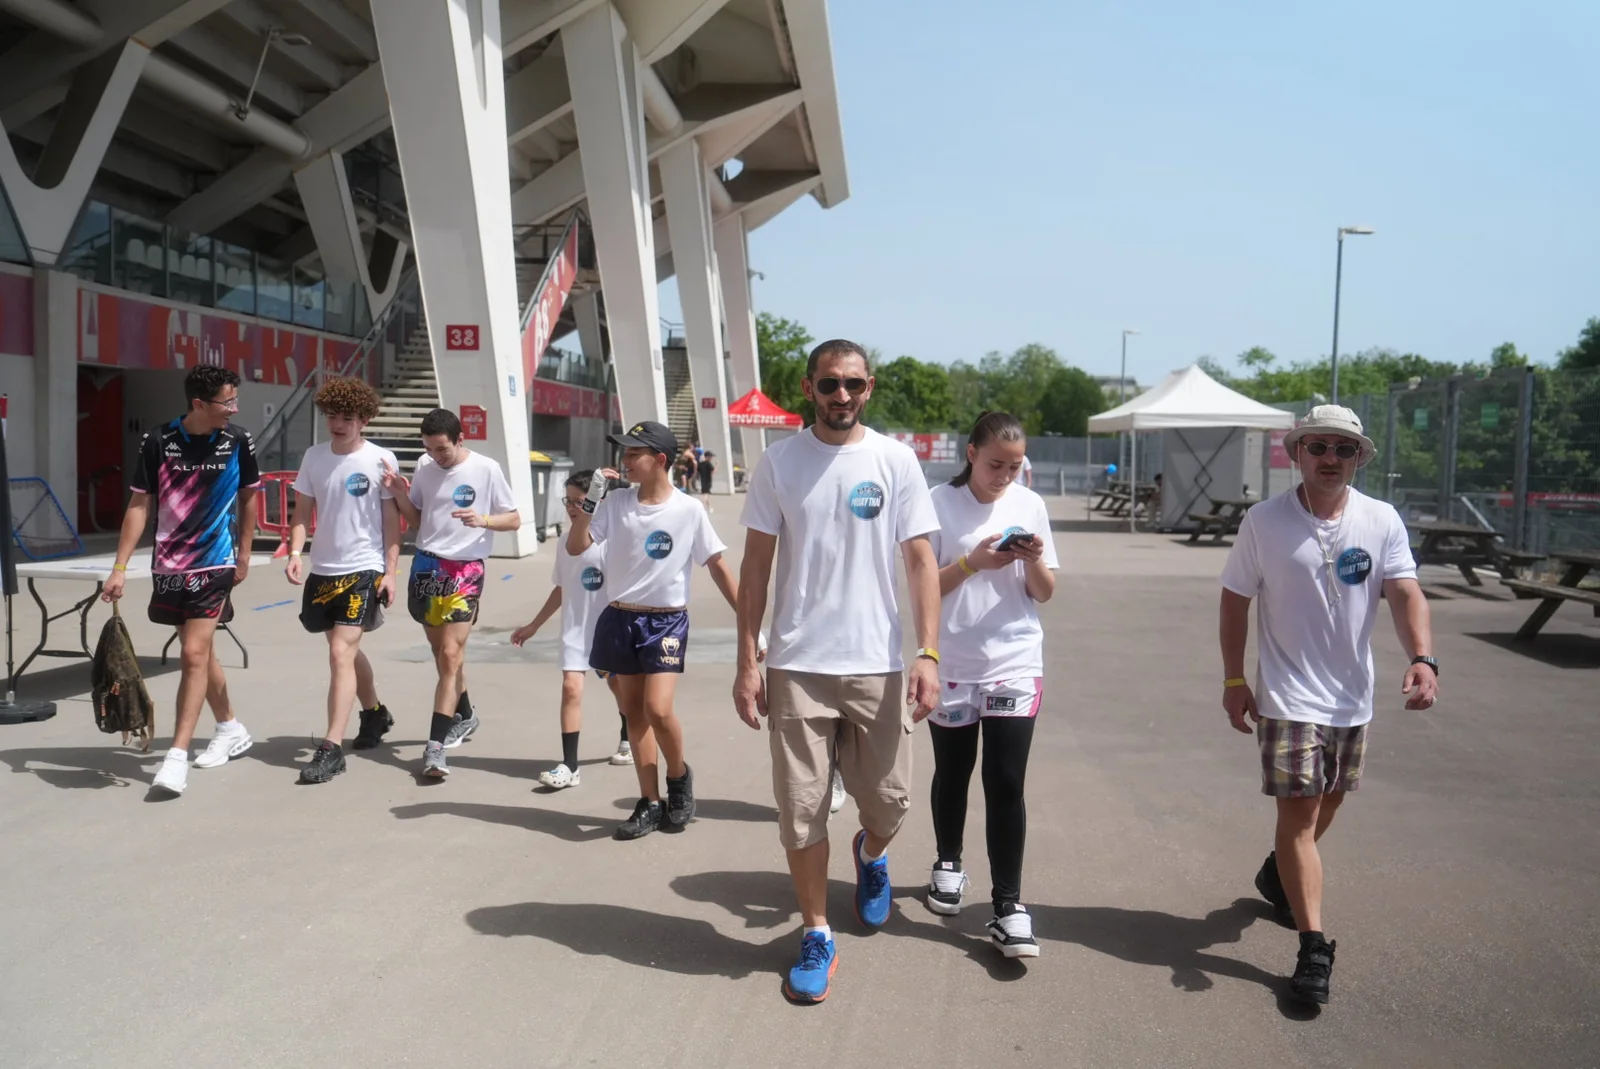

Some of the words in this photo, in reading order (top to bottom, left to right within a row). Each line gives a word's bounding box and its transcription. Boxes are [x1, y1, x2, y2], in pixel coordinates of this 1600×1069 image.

[451, 329, 475, 346] 38
[172, 463, 227, 471] ALPINE
[851, 497, 869, 507] MUAY
